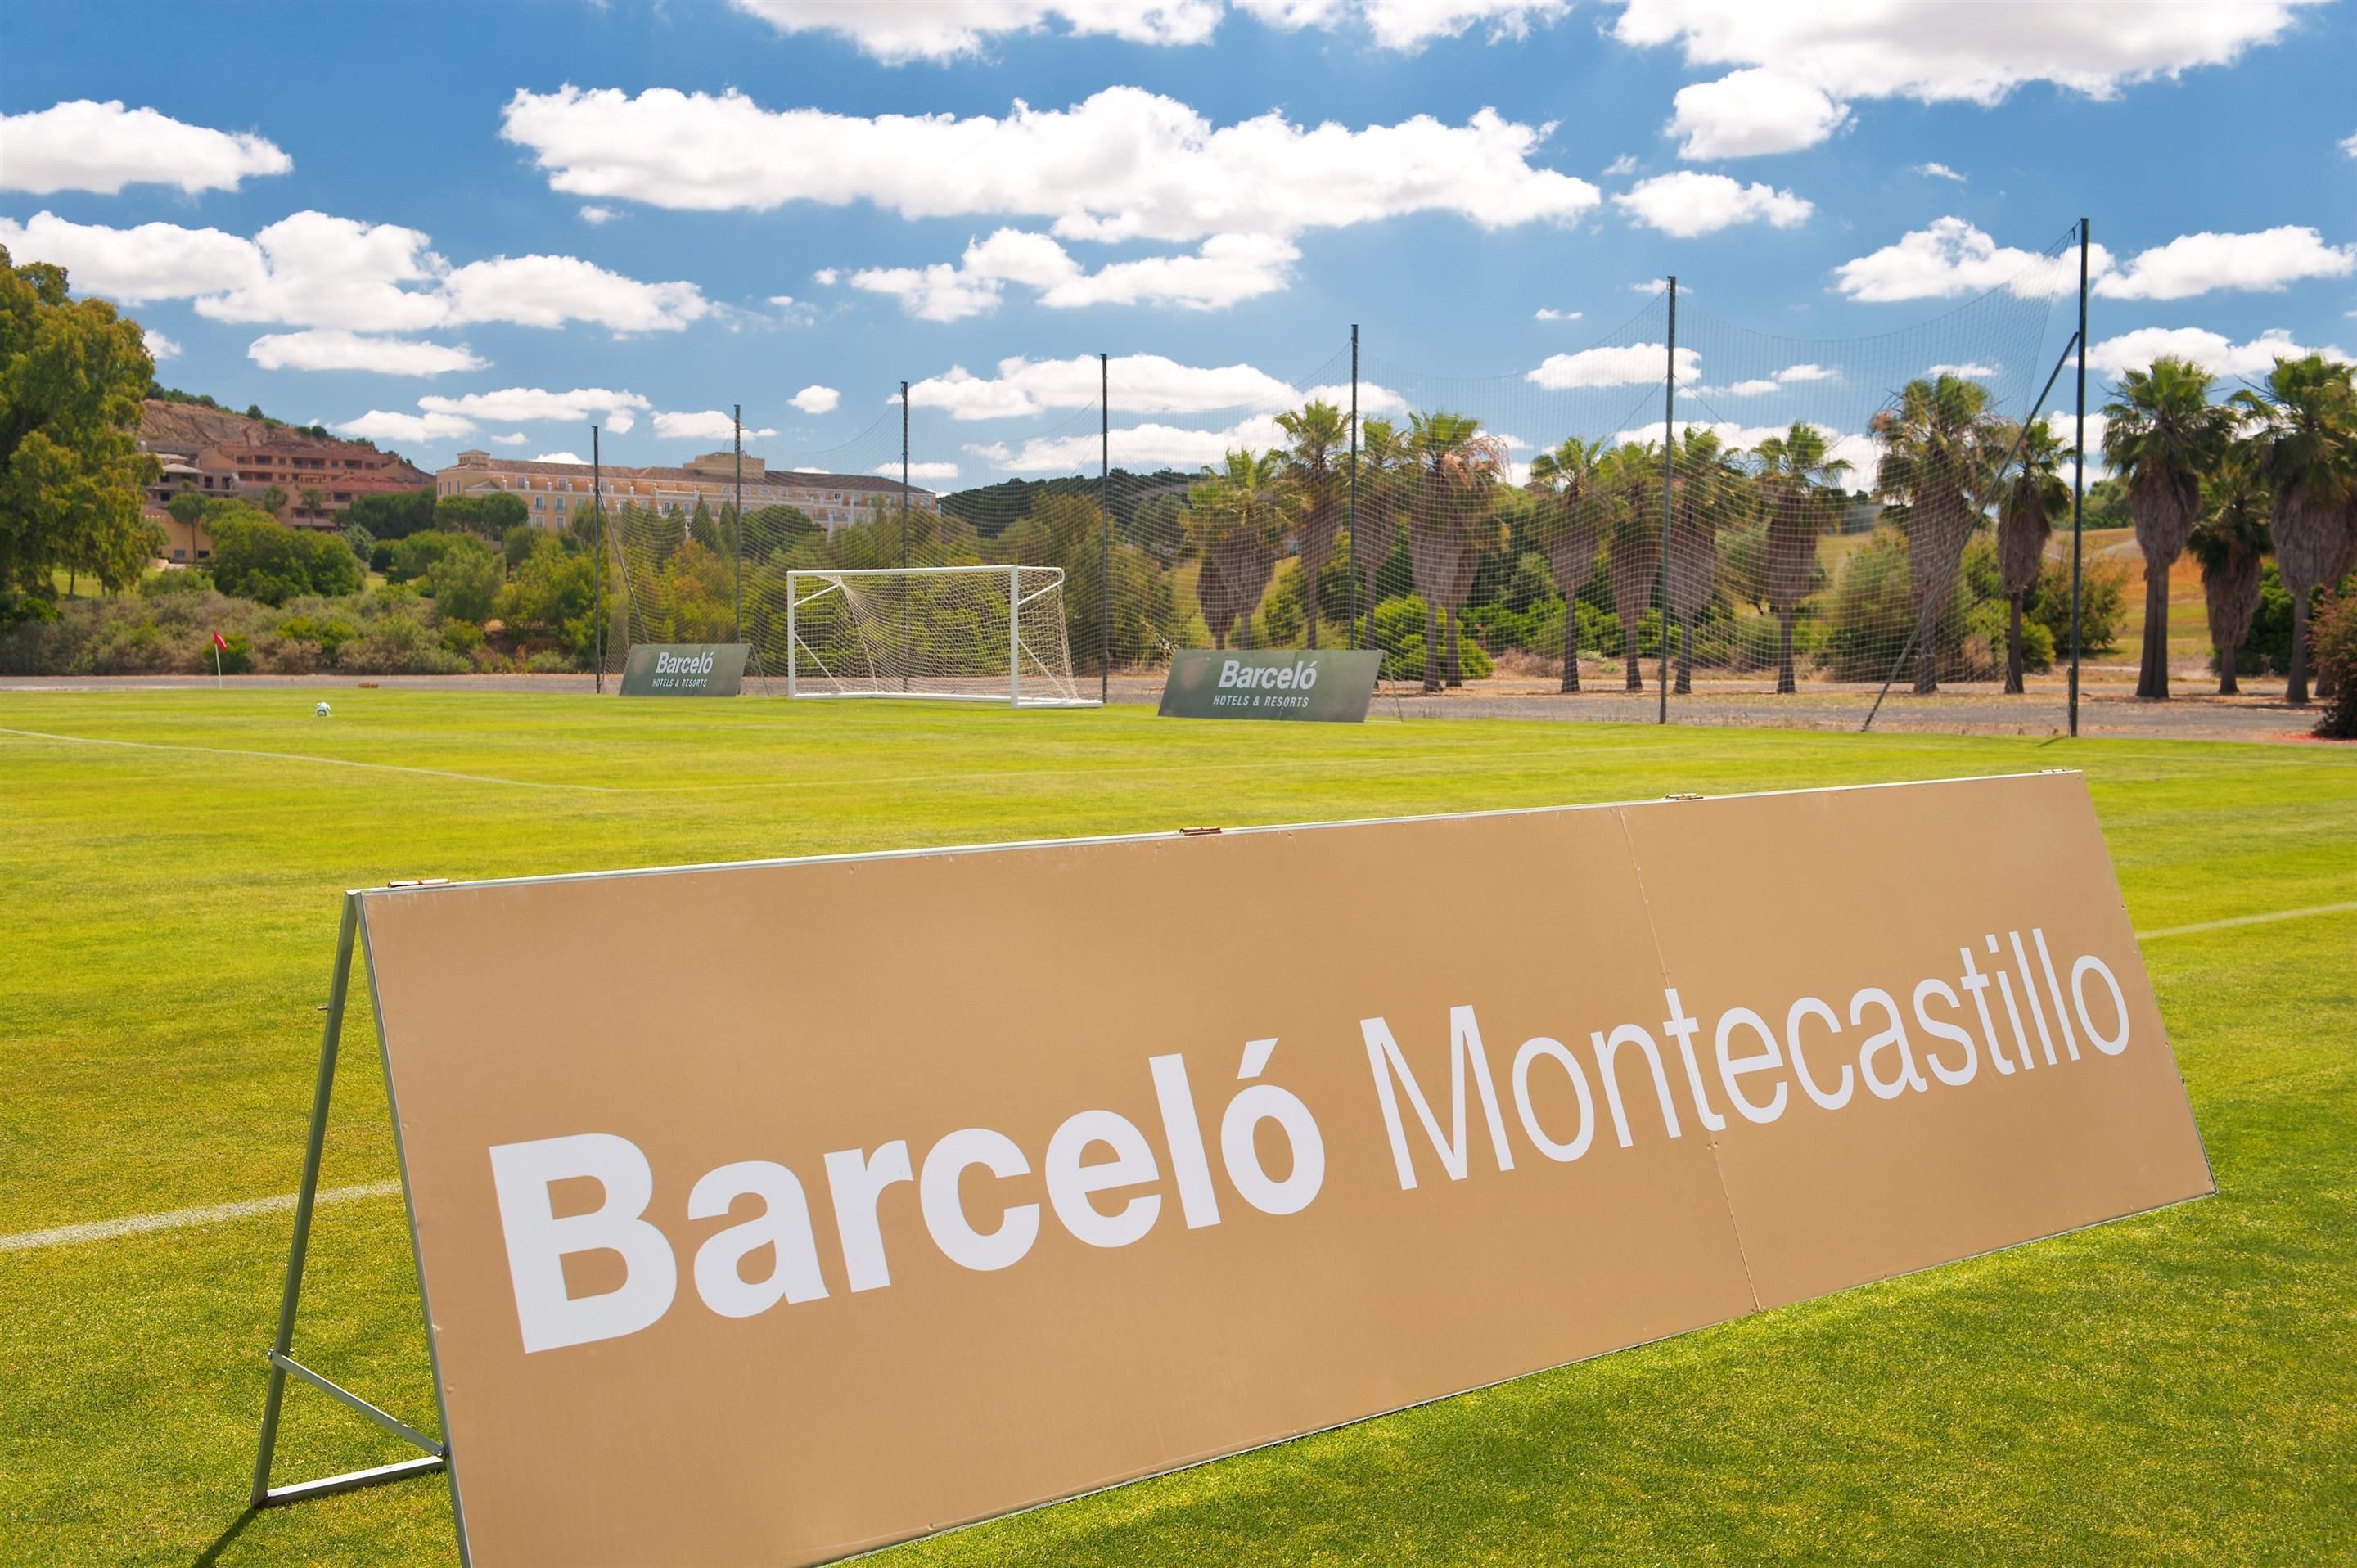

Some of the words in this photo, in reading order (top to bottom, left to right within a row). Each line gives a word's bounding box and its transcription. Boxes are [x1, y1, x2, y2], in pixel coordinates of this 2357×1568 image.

[656, 651, 714, 674] Barceló
[652, 678, 674, 687] HOTELS
[674, 678, 679, 687] &
[681, 678, 707, 687] RESORTS
[1218, 660, 1317, 690] Barceló
[1213, 695, 1250, 706] HOTELS
[1253, 696, 1260, 706] &
[1264, 696, 1309, 708] RESORTS
[489, 1037, 1326, 1354] Barceló
[1360, 927, 2132, 1191] Montecastillo
